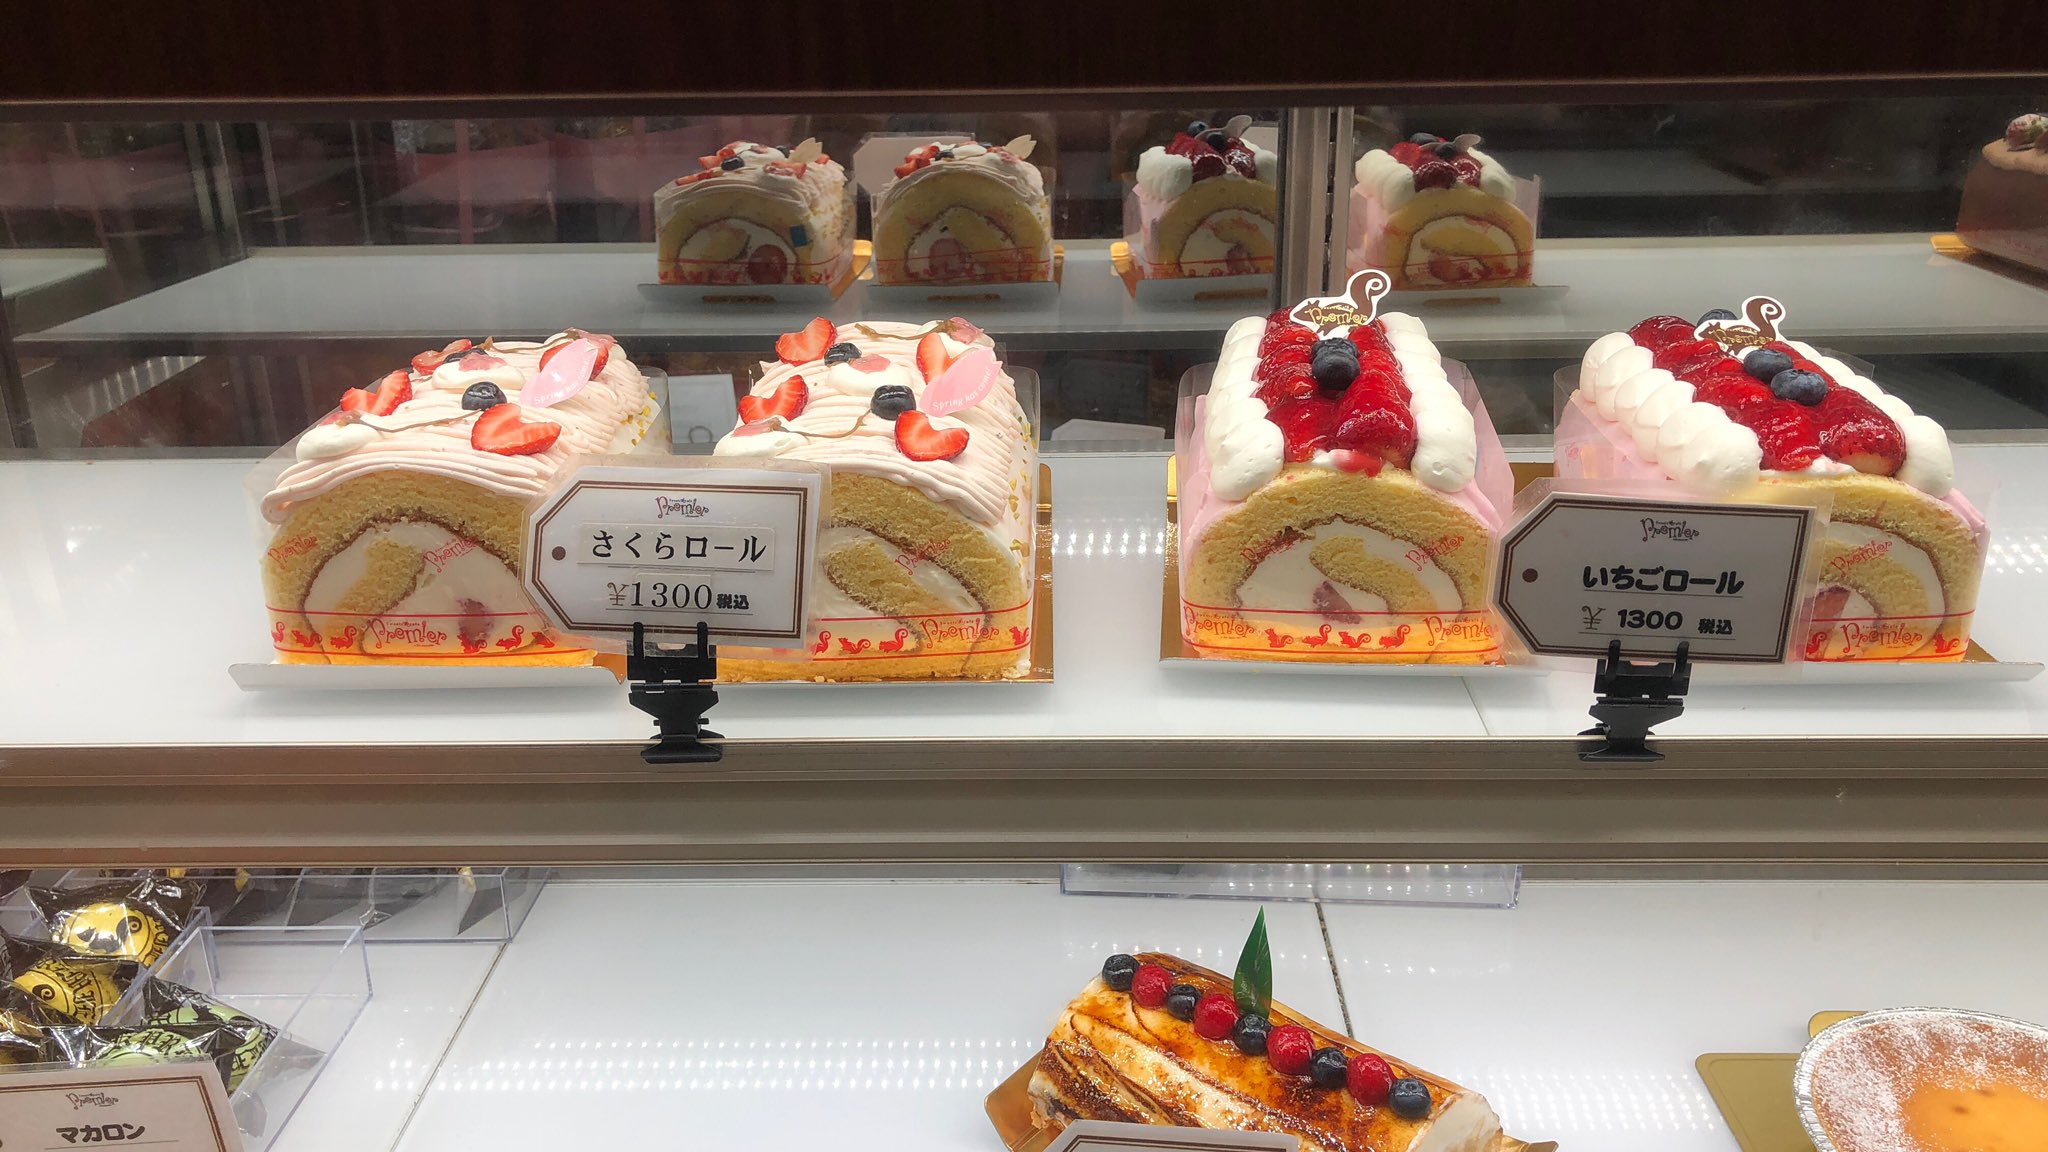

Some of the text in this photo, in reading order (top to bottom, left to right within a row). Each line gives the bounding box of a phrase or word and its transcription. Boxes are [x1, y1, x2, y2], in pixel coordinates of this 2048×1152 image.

[1303, 307, 1368, 327] Premier
[655, 496, 710, 519] Premier
[591, 528, 768, 564] さくらロール
[1640, 517, 1700, 542] Premier
[267, 532, 319, 570] Premier
[422, 534, 478, 574] Premier
[1404, 534, 1465, 572] Premier
[1829, 538, 1893, 577] Premier
[1582, 563, 1745, 597] いちごロール
[368, 615, 448, 649] Premier
[919, 616, 1000, 649] Premier
[1182, 604, 1256, 643] Premier
[1617, 608, 1684, 632] 1300
[1697, 617, 1734, 636] 税込
[1840, 621, 1924, 654] Premier
[65, 1091, 120, 1111] Premier
[55, 1121, 147, 1145] マカロン
